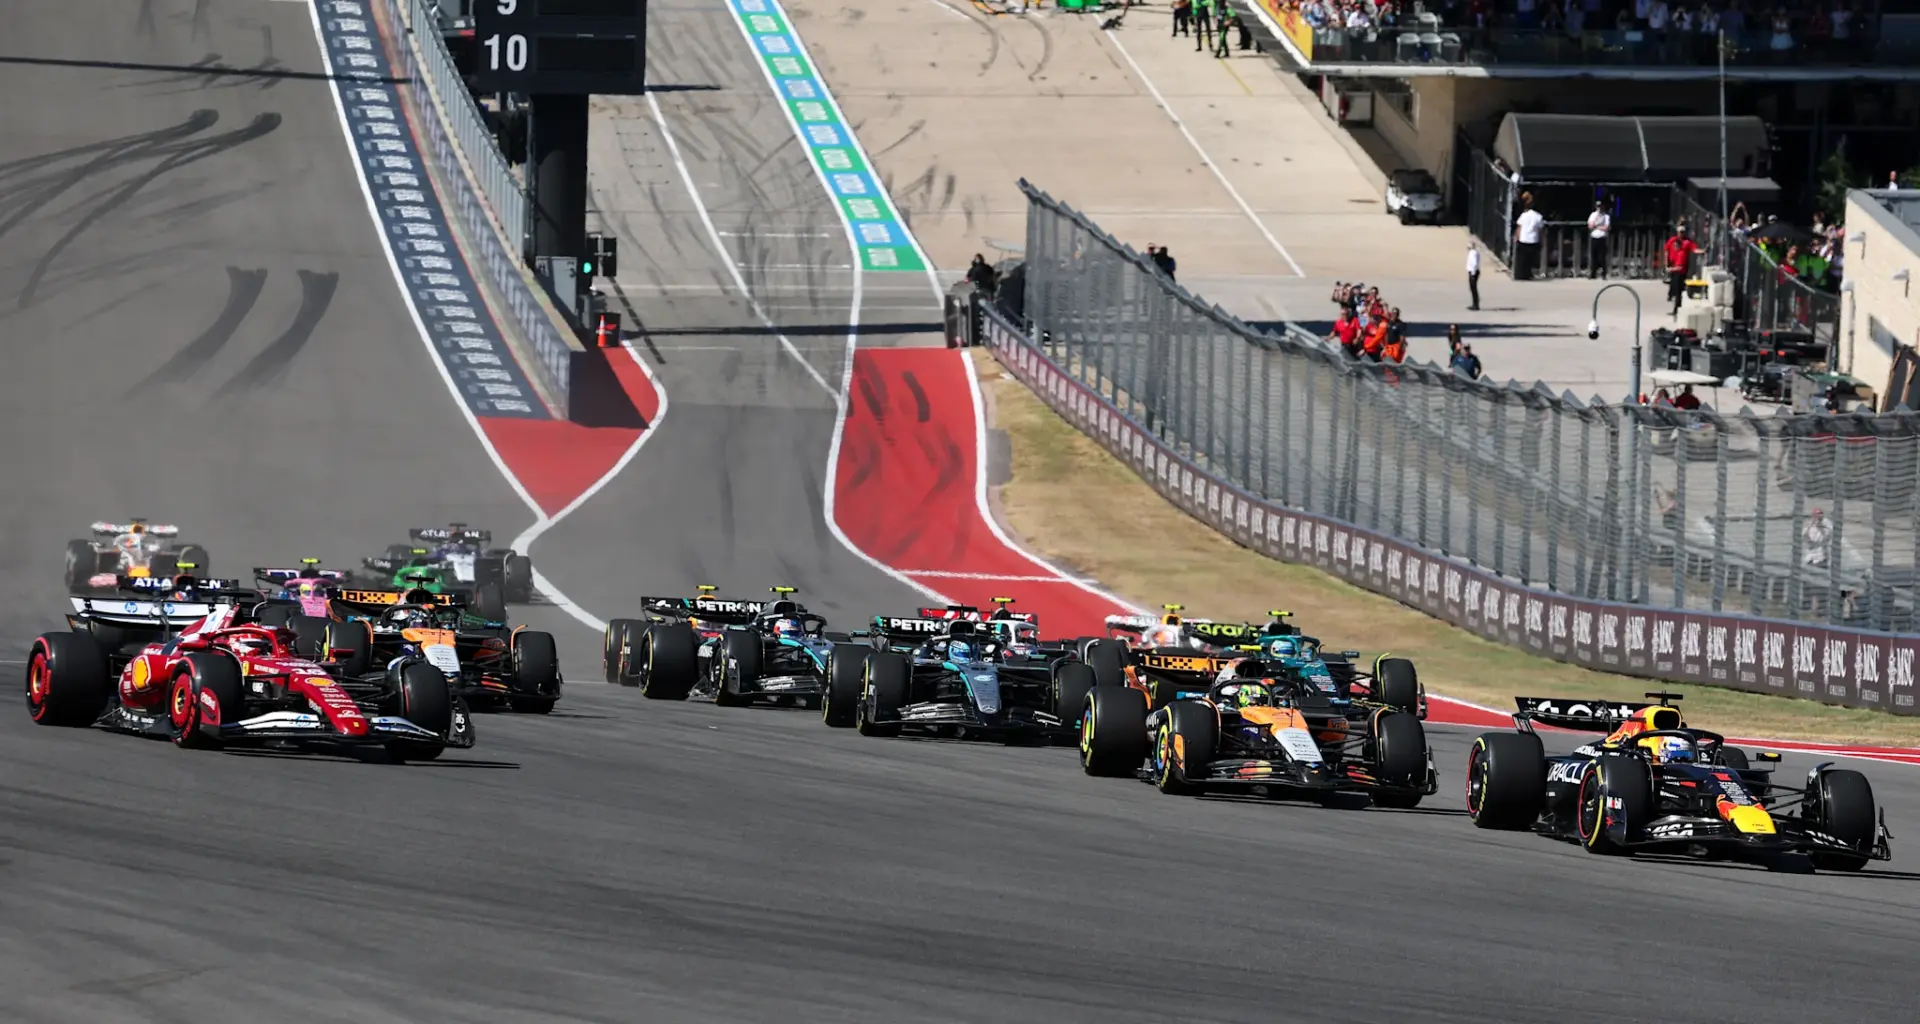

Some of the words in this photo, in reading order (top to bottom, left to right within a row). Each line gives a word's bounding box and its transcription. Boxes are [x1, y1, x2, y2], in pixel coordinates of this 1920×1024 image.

[484, 34, 527, 71] 10
[126, 602, 137, 612] hp
[1742, 628, 1757, 664] MSC
[1770, 632, 1785, 669] MSC
[1800, 636, 1816, 673] MSC
[1830, 640, 1846, 678] MSC
[1863, 643, 1880, 683] MSC
[1896, 647, 1915, 687] MSC
